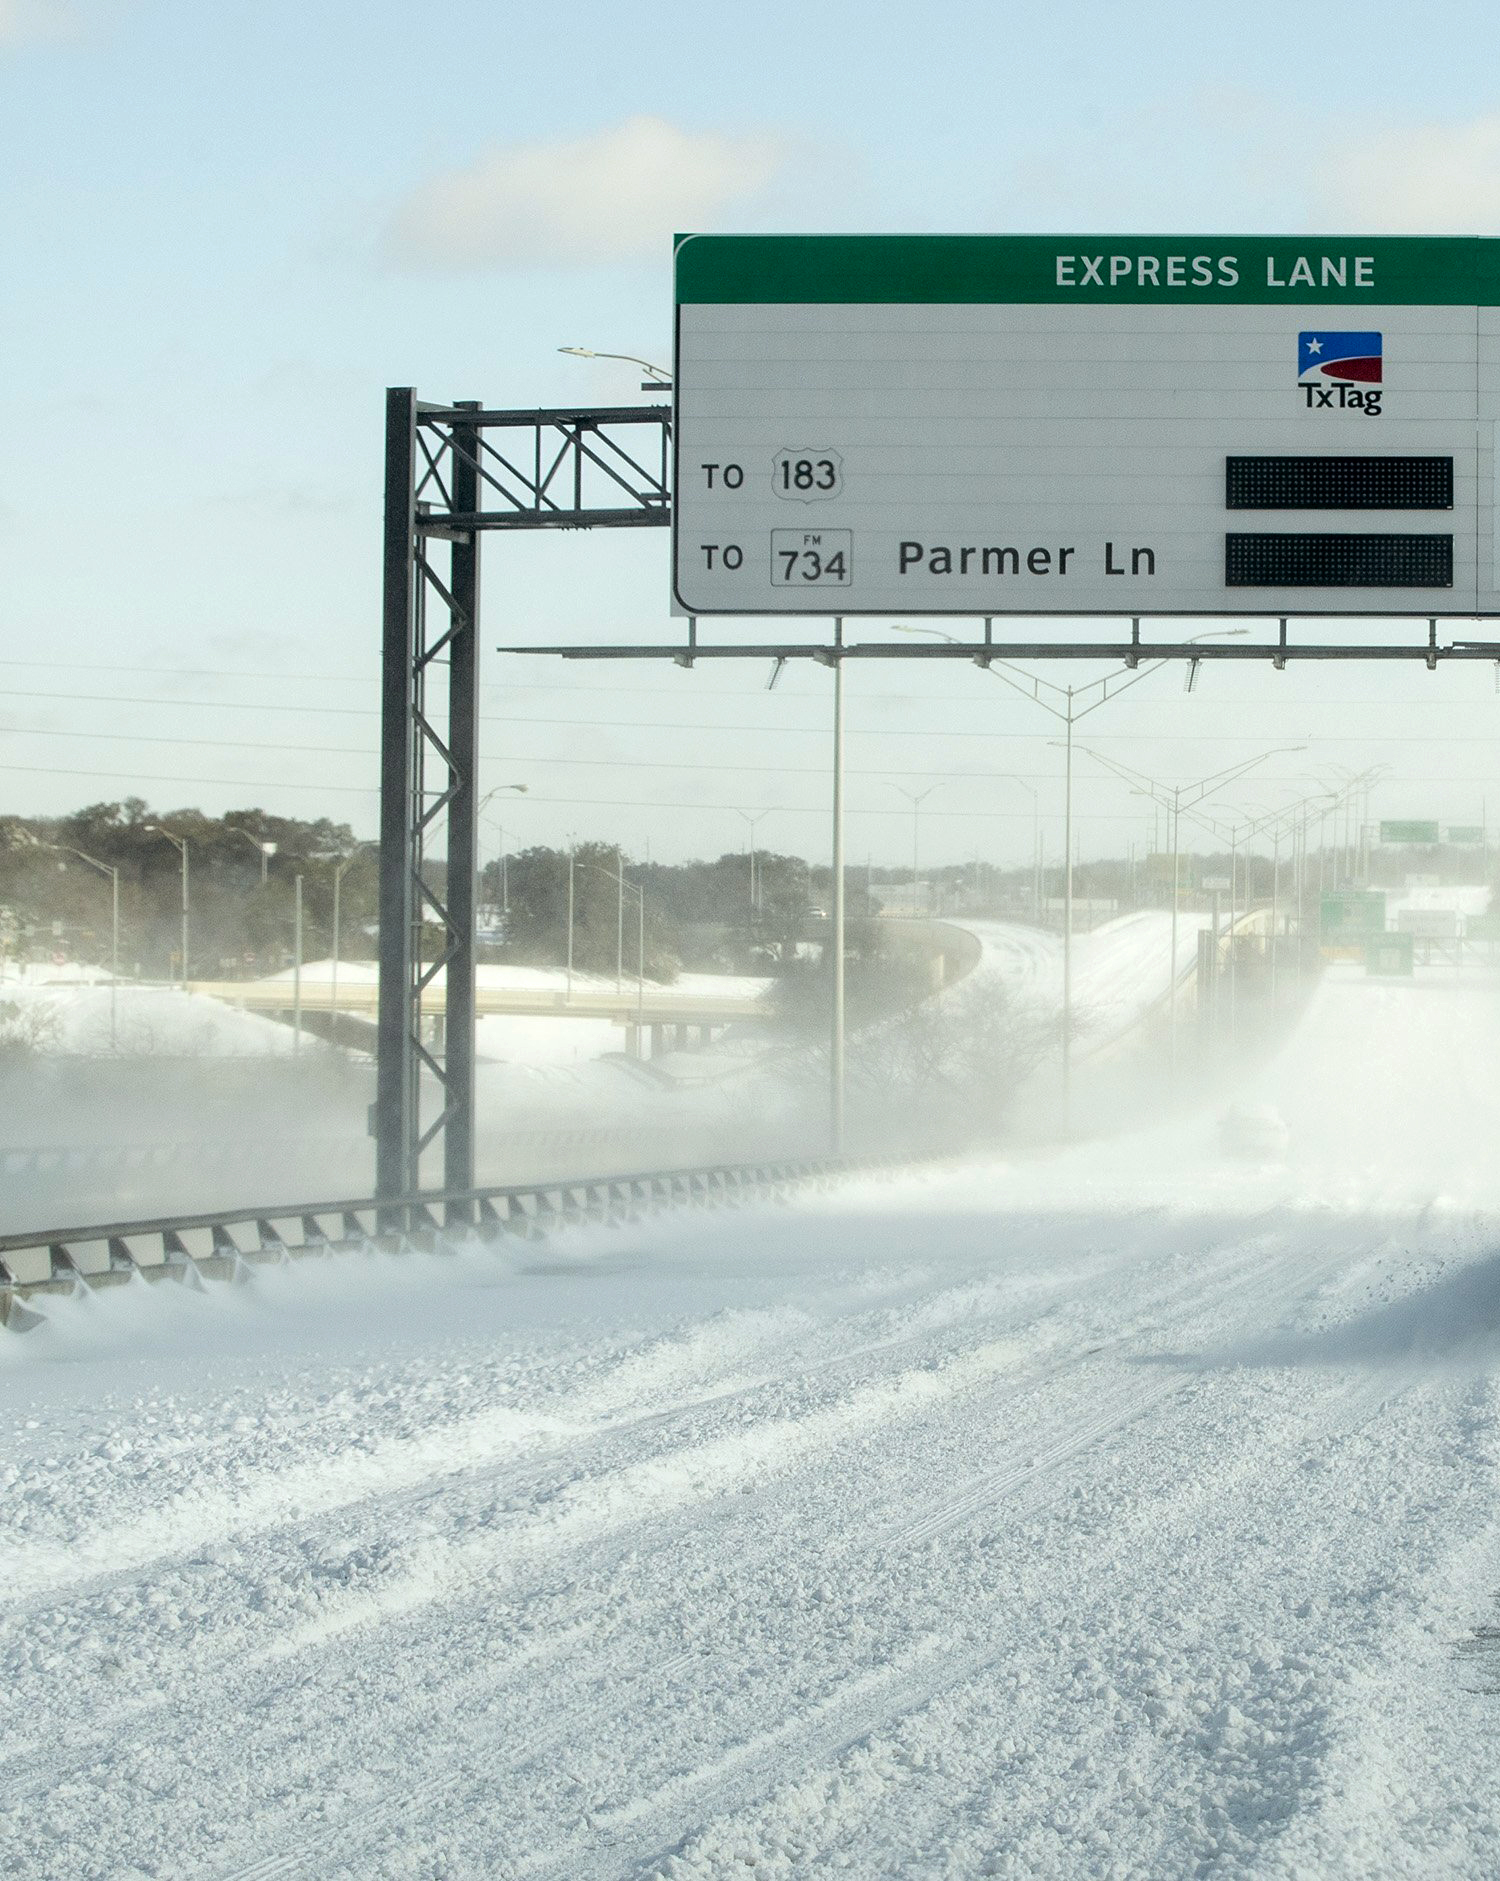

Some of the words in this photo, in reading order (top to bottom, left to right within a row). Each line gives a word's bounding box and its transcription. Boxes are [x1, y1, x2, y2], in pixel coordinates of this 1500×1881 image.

[1057, 256, 1238, 286] EXPRESS
[1268, 257, 1374, 286] LANE
[1298, 382, 1382, 416] TxTag
[702, 464, 743, 489] TO
[782, 460, 835, 489] 183
[803, 535, 821, 545] FM
[701, 545, 742, 569] TO
[779, 551, 845, 580] 734
[900, 542, 1074, 574] Parmer
[1106, 543, 1154, 574] Ln
